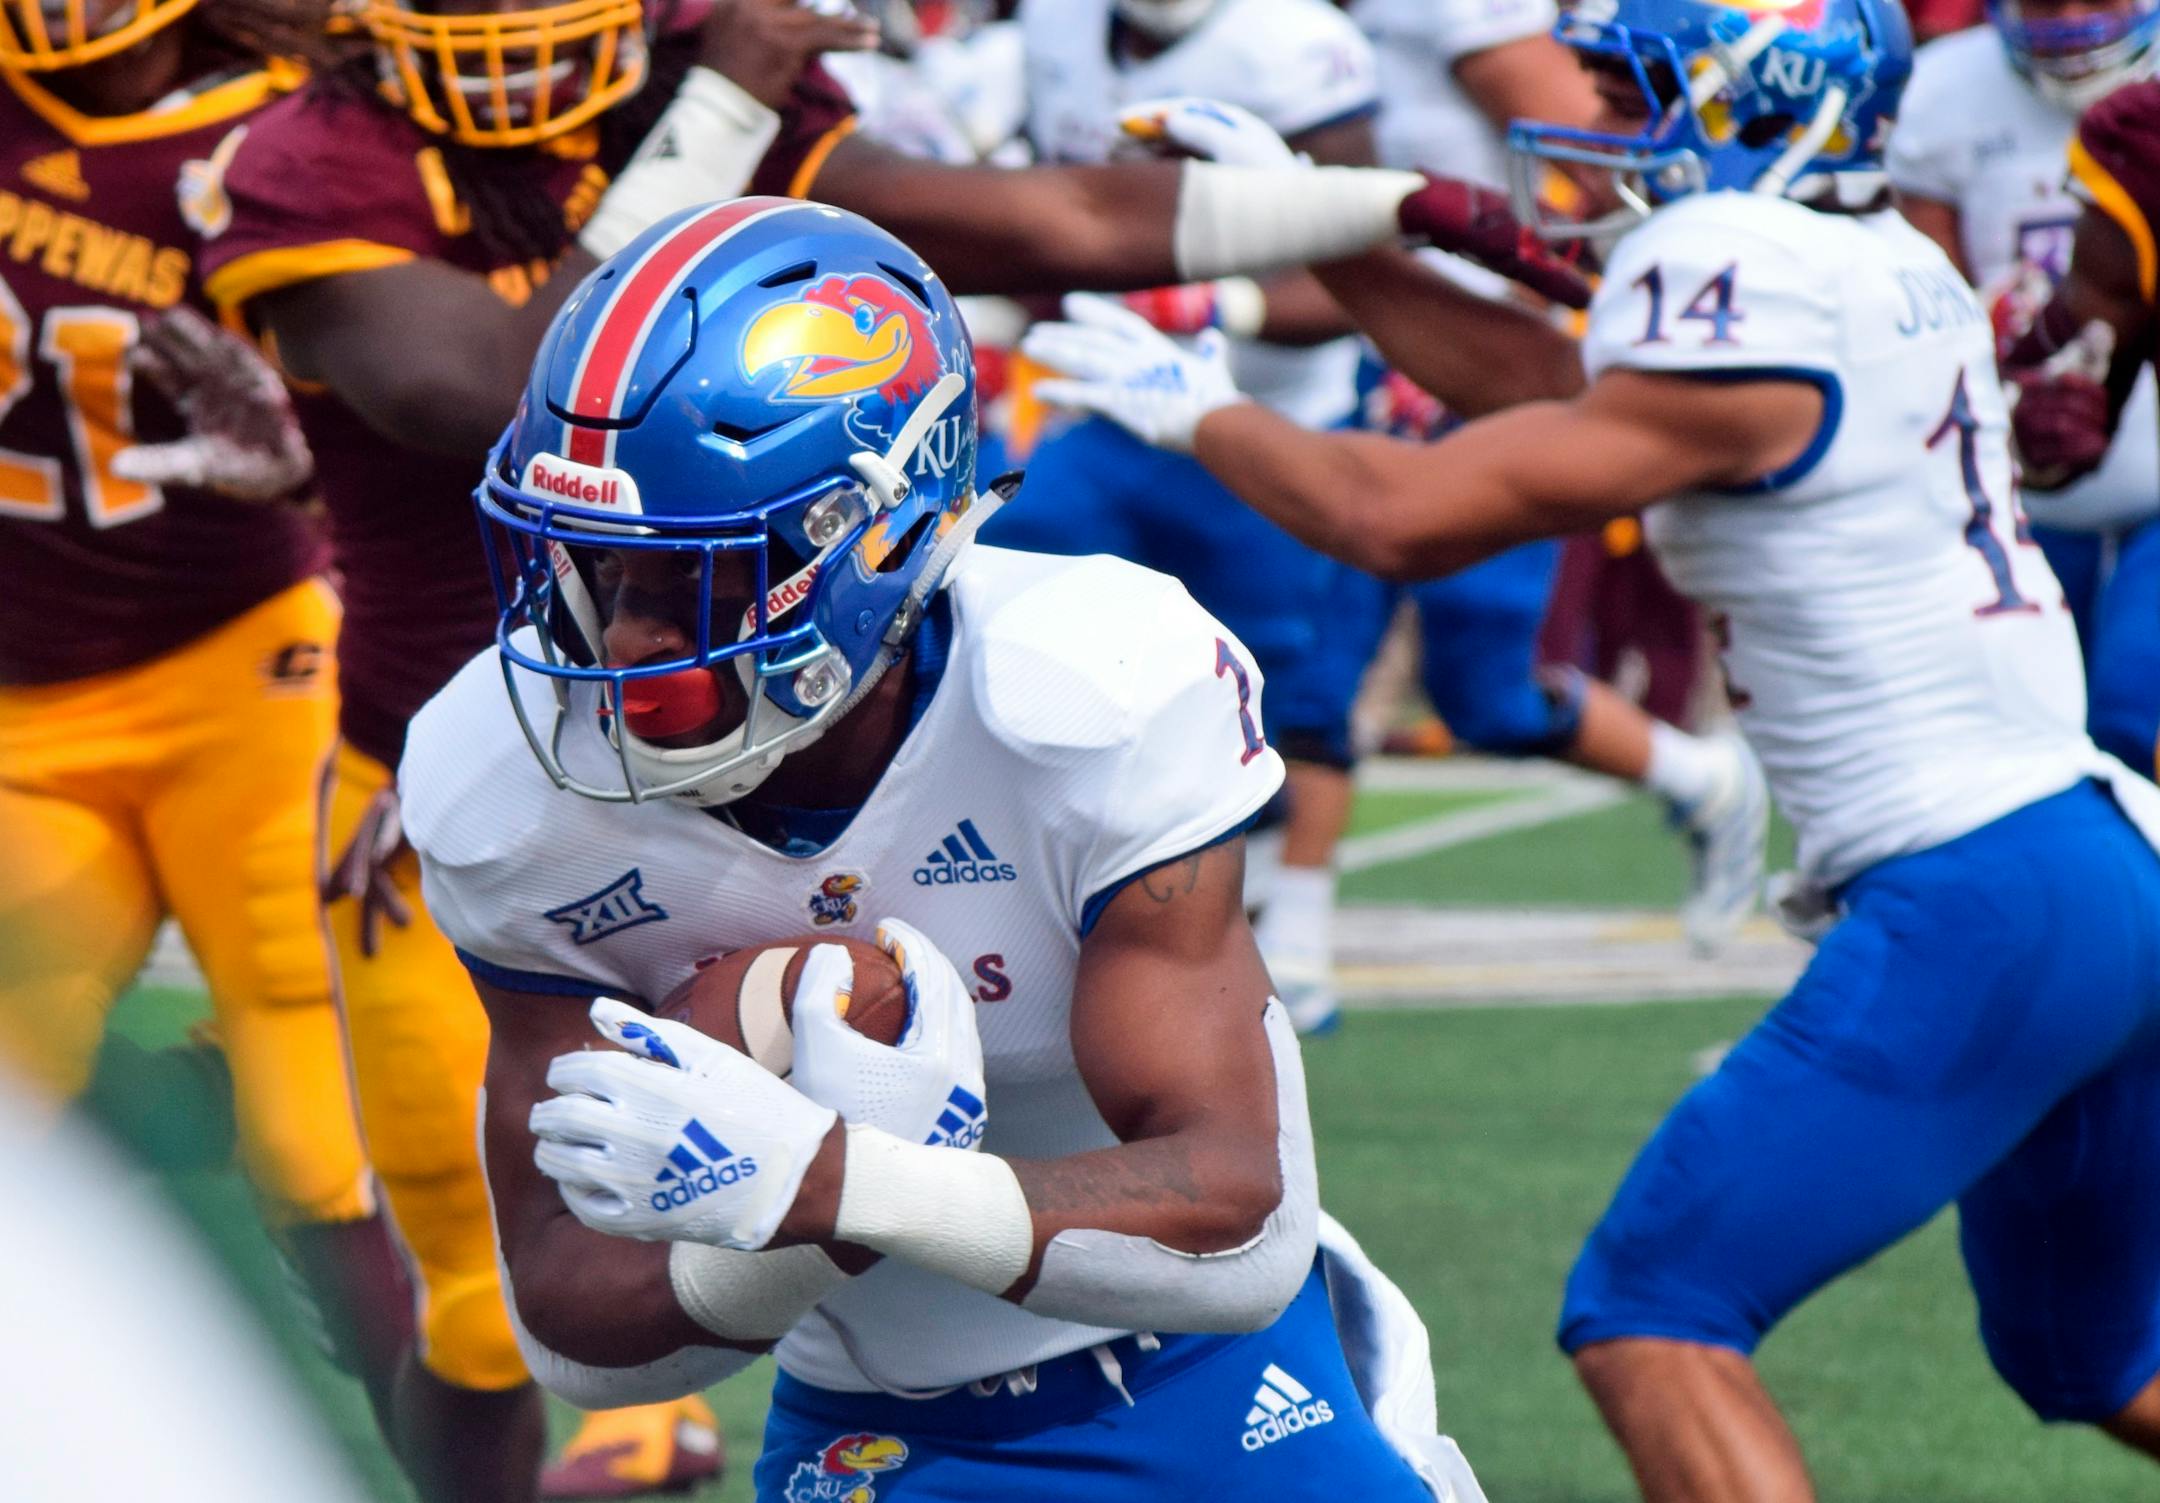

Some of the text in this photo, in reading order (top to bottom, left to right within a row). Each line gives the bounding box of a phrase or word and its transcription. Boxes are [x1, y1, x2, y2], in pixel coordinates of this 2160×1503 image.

[1631, 262, 1746, 347] 14
[914, 415, 961, 478] KU
[533, 464, 618, 505] Riddell
[913, 860, 1017, 886] adidas
[545, 868, 669, 945] XII
[651, 1155, 757, 1212] adidas
[1241, 1399, 1335, 1452] adidas
[814, 1480, 841, 1499] KU
